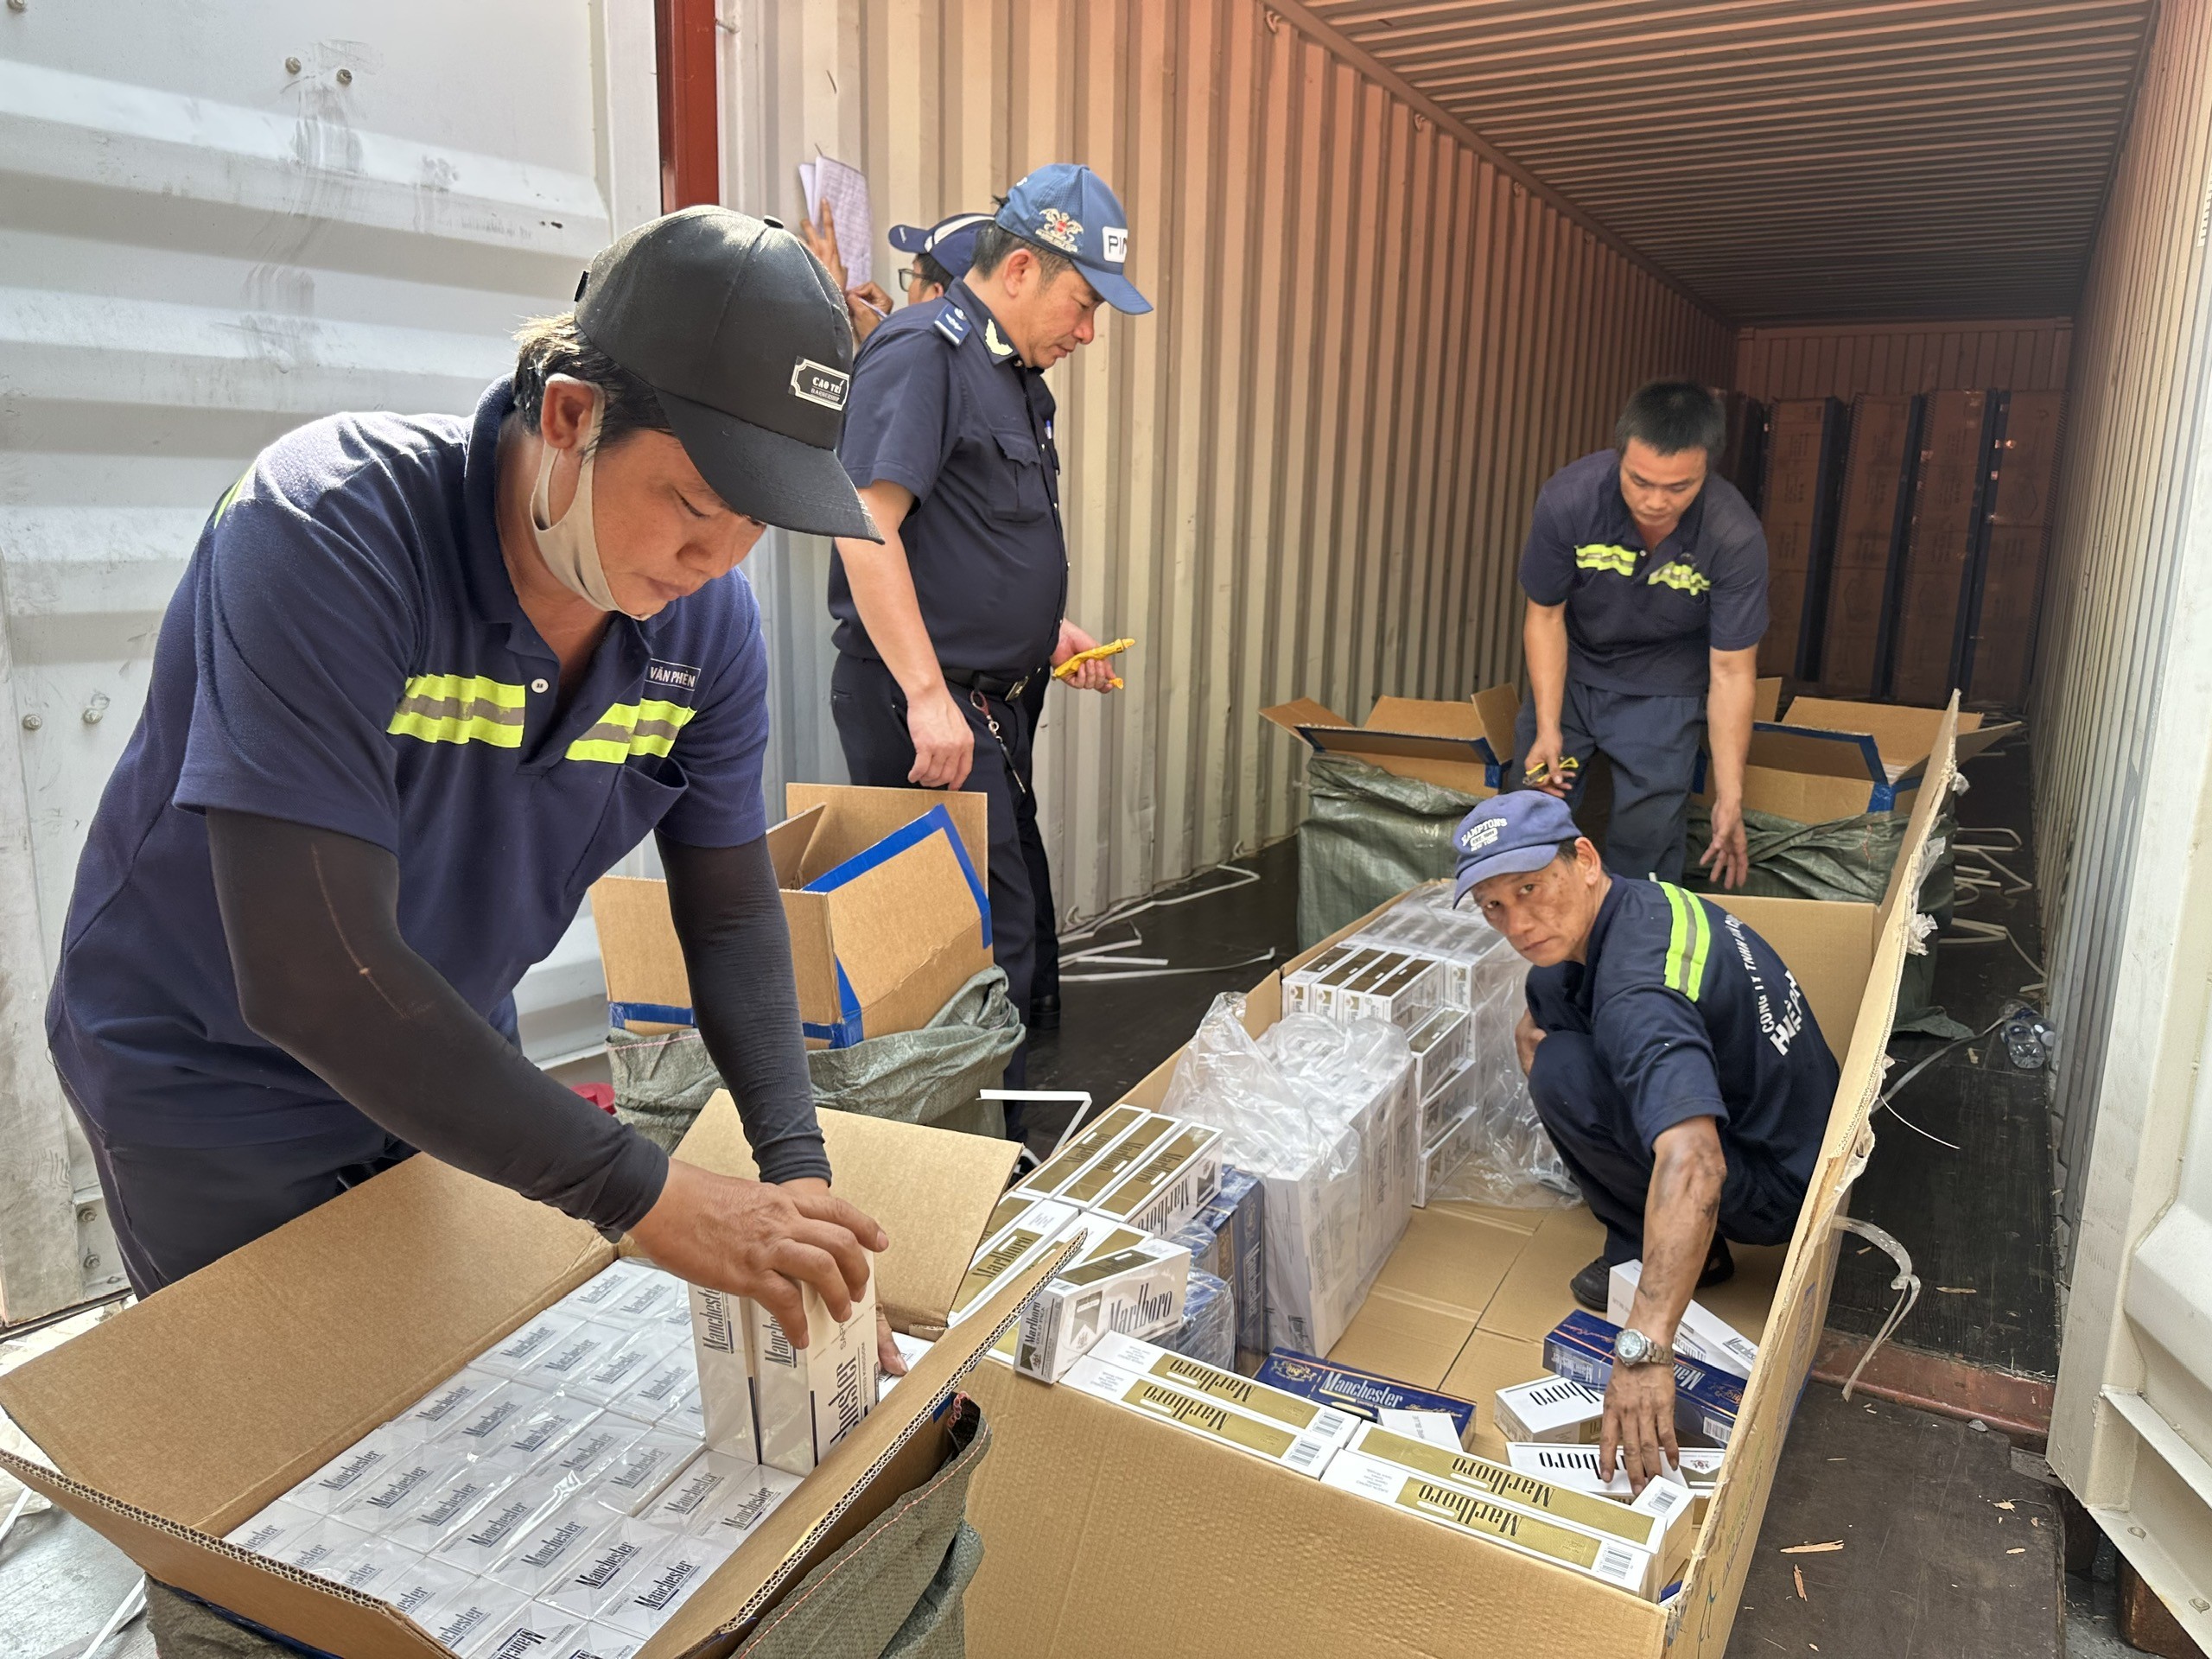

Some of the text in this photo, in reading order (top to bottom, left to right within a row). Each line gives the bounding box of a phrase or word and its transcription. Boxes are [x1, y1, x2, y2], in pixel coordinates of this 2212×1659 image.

[812, 377, 830, 390] CAO
[971, 1236, 1033, 1278] Marlboro
[697, 1287, 729, 1354] Manchest
[1025, 1301, 1040, 1344] Marlboro
[1109, 1282, 1173, 1334] Marlboro
[762, 1316, 793, 1368] Manch
[829, 1356, 859, 1445] hester
[1169, 1358, 1256, 1403] Marlboro
[1322, 1371, 1403, 1409] Manchester
[1529, 1380, 1600, 1406] lboro
[416, 1386, 470, 1421] Manchester
[462, 1401, 517, 1439] Manchester
[1142, 1384, 1232, 1432] Marlboro
[510, 1415, 566, 1452] Manchester
[559, 1433, 614, 1471] Manchester
[319, 1450, 380, 1491] Manchester
[366, 1465, 428, 1509] Manchester
[611, 1447, 664, 1490] Manchester
[1452, 1456, 1556, 1508] Marlboro
[1539, 1452, 1603, 1479] boro
[416, 1483, 478, 1527] Manchester
[664, 1472, 718, 1516] Manchester
[721, 1487, 775, 1530] Manchester
[1418, 1483, 1524, 1537] Marlboro
[236, 1524, 279, 1550] hester
[467, 1502, 528, 1548] Manchester
[521, 1521, 582, 1568] Manchester
[343, 1562, 377, 1587] ester
[575, 1541, 637, 1589] Manchester
[633, 1560, 694, 1611] Manchester
[436, 1606, 484, 1645] nchester
